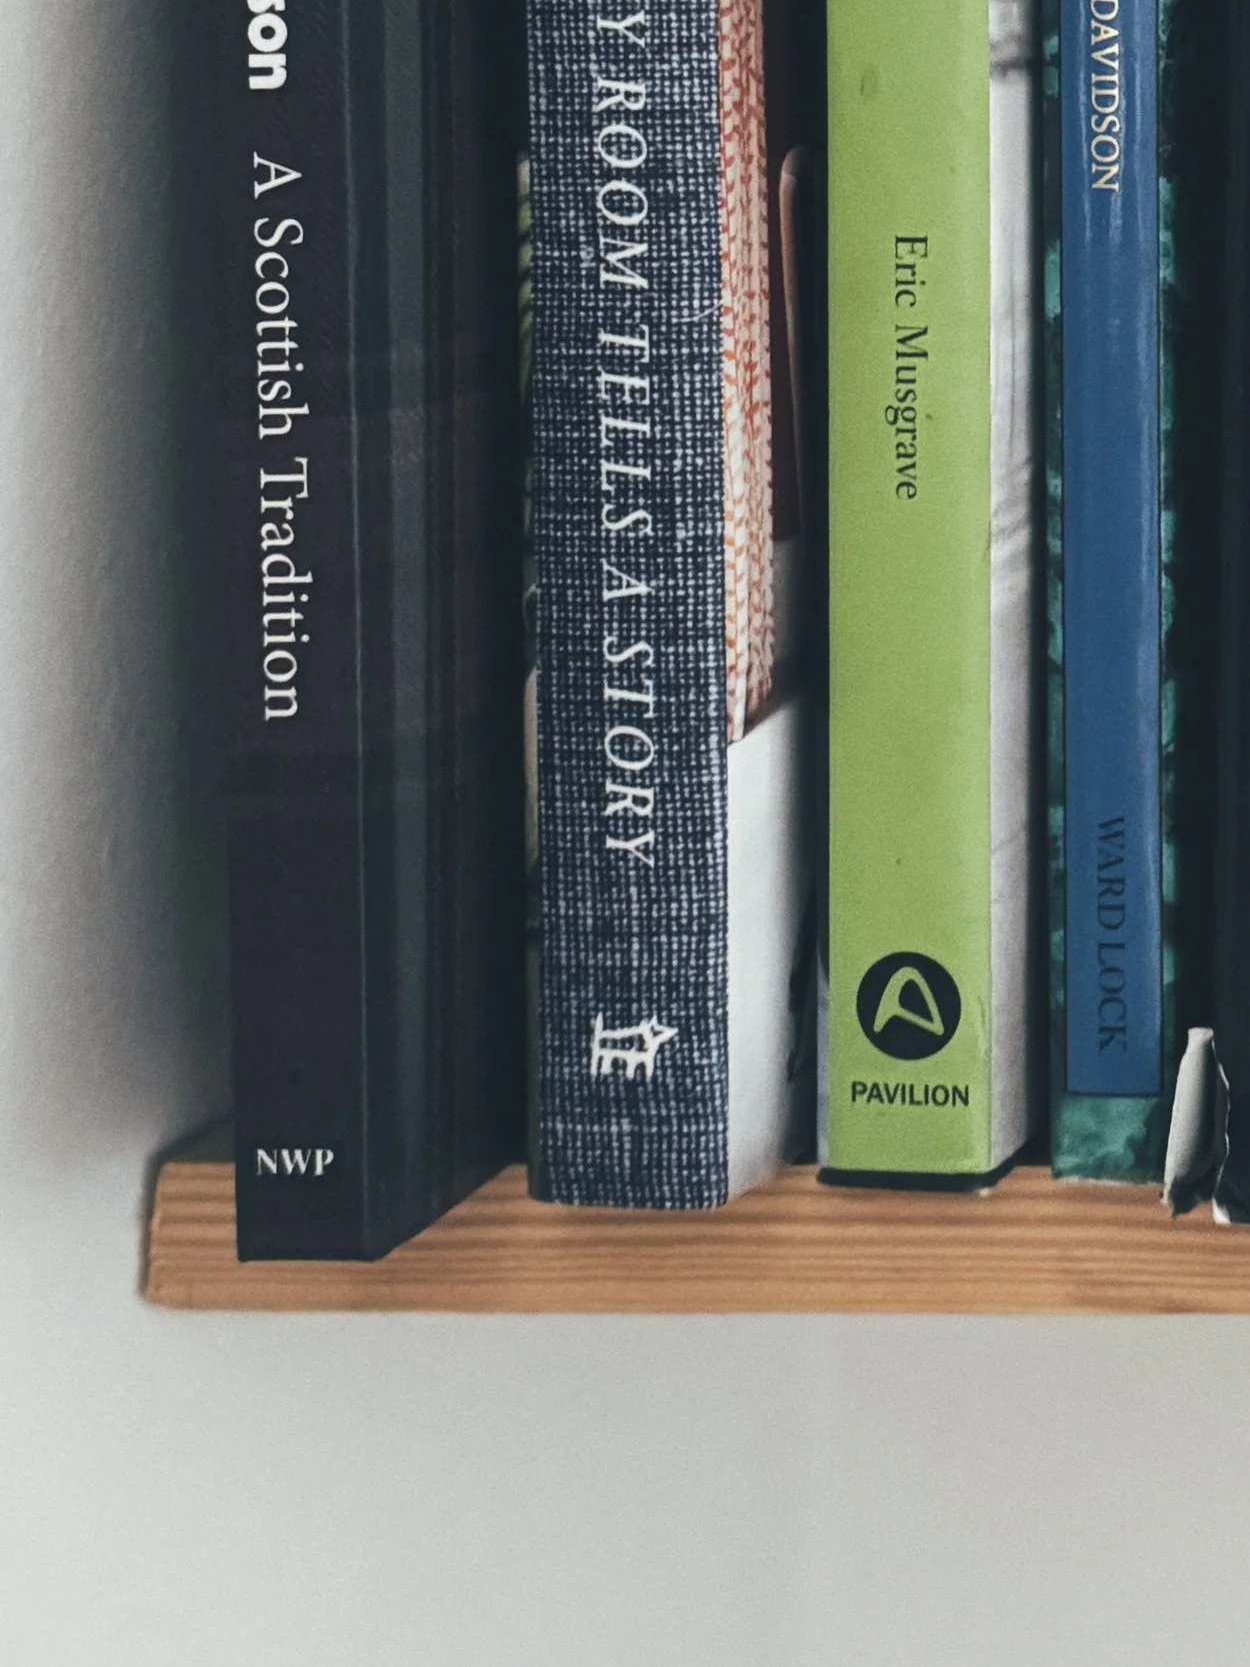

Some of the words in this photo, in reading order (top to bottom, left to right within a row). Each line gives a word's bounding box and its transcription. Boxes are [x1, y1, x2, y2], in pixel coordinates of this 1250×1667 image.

[252, 151, 303, 199] A
[593, 74, 651, 291] ROOM
[253, 216, 311, 440] Scottish
[894, 233, 930, 308] Eric
[598, 324, 653, 536] TELLS
[883, 324, 930, 501] Musgrave
[259, 456, 314, 723] Tradition
[602, 558, 653, 602] A
[602, 637, 656, 869] STORY
[1095, 815, 1127, 933] WARD
[1096, 939, 1128, 1055] LOCK
[850, 1079, 970, 1108] PAVILION
[255, 1147, 335, 1176] NWP
